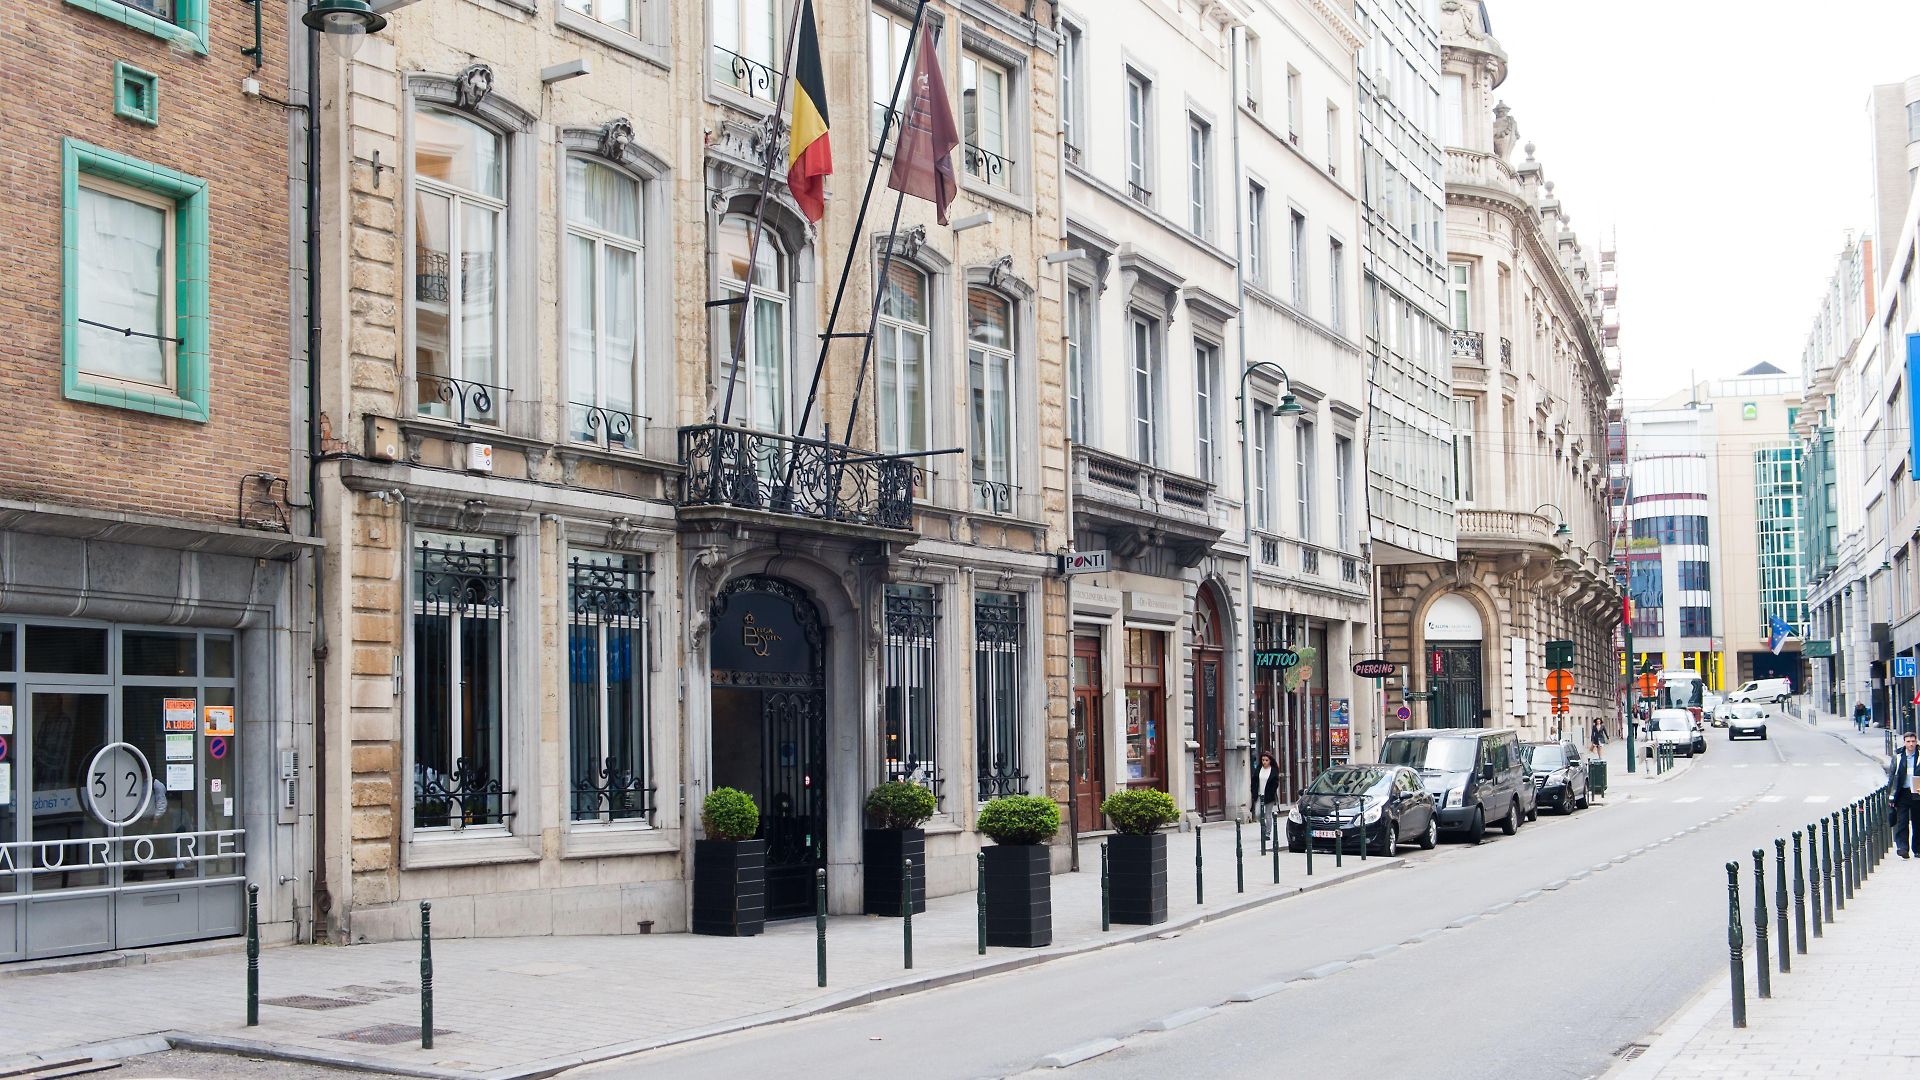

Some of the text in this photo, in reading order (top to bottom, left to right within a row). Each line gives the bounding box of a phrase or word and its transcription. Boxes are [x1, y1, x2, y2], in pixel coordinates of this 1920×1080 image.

[1256, 652, 1297, 666] TATTOO
[1355, 664, 1393, 674] PIERCING
[173, 720, 194, 729] LOUER
[0, 832, 236, 873] AURORE
